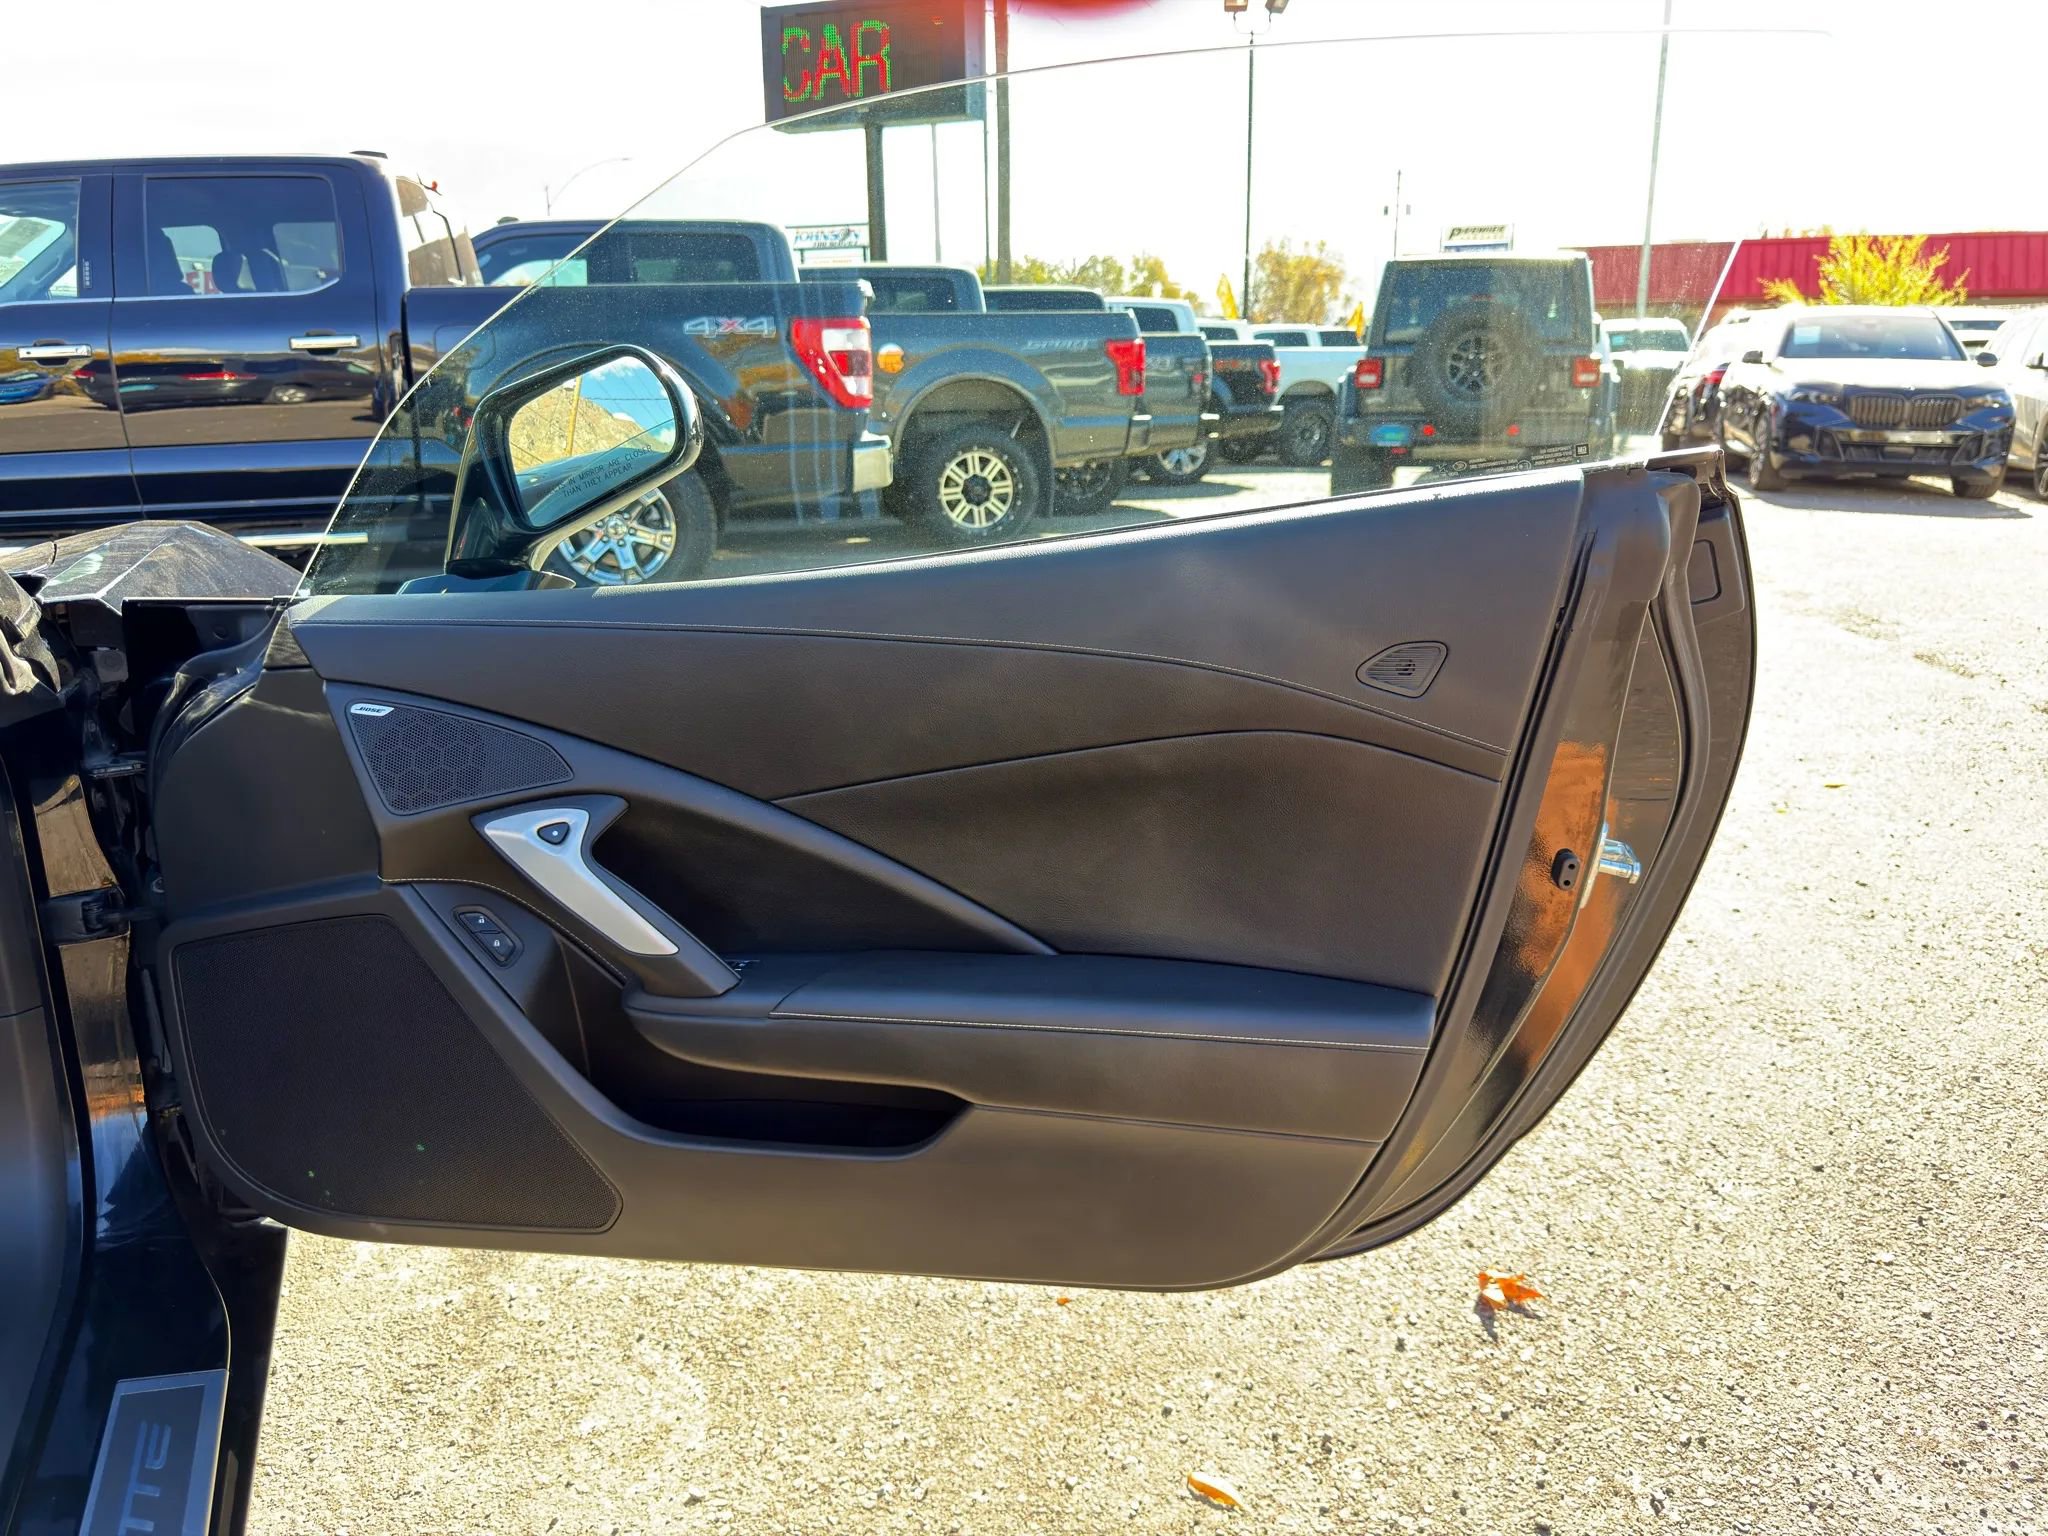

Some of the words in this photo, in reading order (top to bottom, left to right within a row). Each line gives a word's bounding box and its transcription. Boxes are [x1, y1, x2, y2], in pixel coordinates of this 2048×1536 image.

[782, 20, 890, 102] CAR
[563, 485, 581, 497] THAN
[584, 477, 601, 489] THEY
[604, 463, 632, 479] APPEAR
[568, 478, 576, 486] IN
[579, 464, 604, 481] MIRROR
[608, 458, 619, 467] ARE
[624, 444, 653, 461] CLOSER
